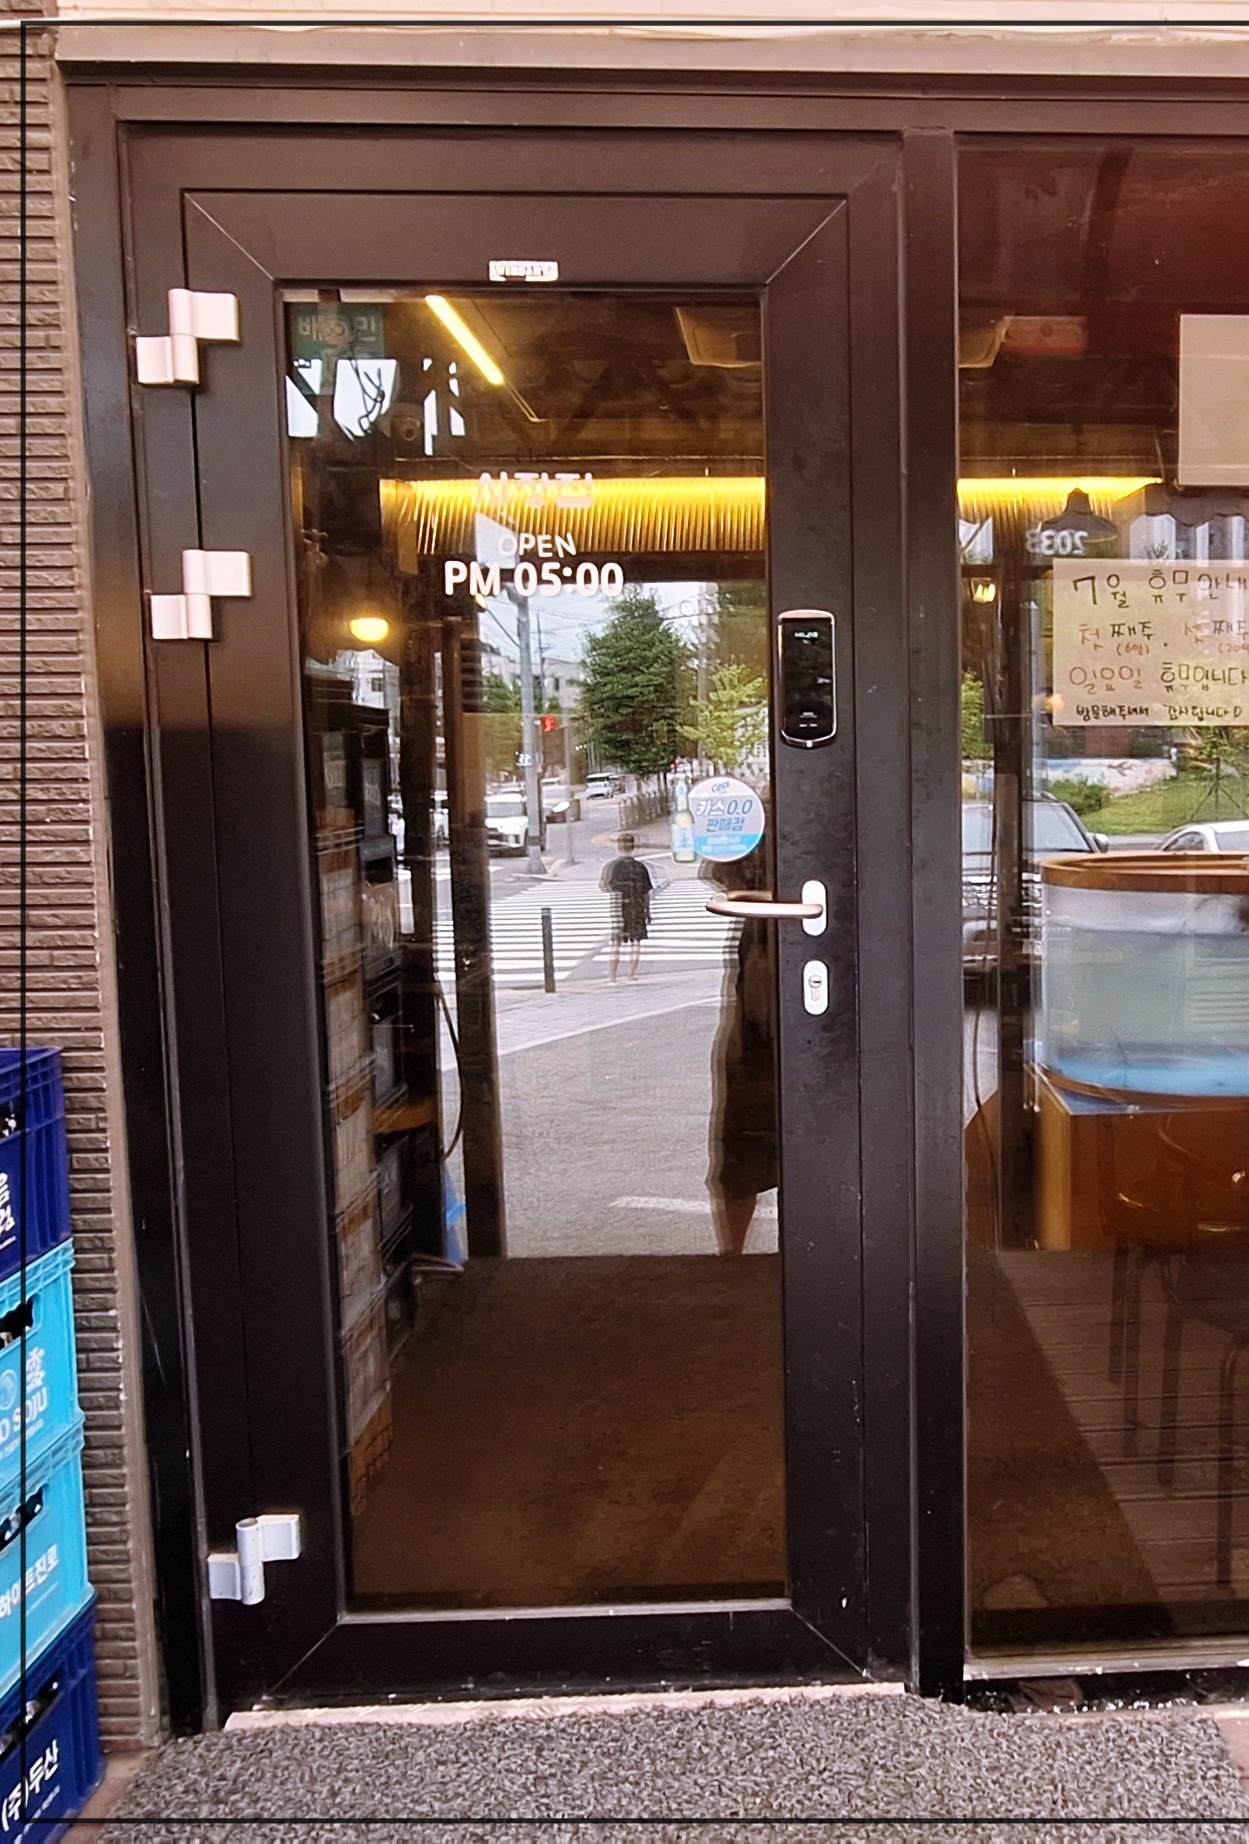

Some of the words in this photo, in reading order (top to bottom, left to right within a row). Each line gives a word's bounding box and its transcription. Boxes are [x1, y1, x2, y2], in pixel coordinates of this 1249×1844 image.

[497, 531, 577, 559] OPEN
[444, 560, 501, 597] PM
[513, 561, 624, 598] 05:00
[1072, 573, 1130, 609] 7월
[1069, 666, 1143, 694] 일요일
